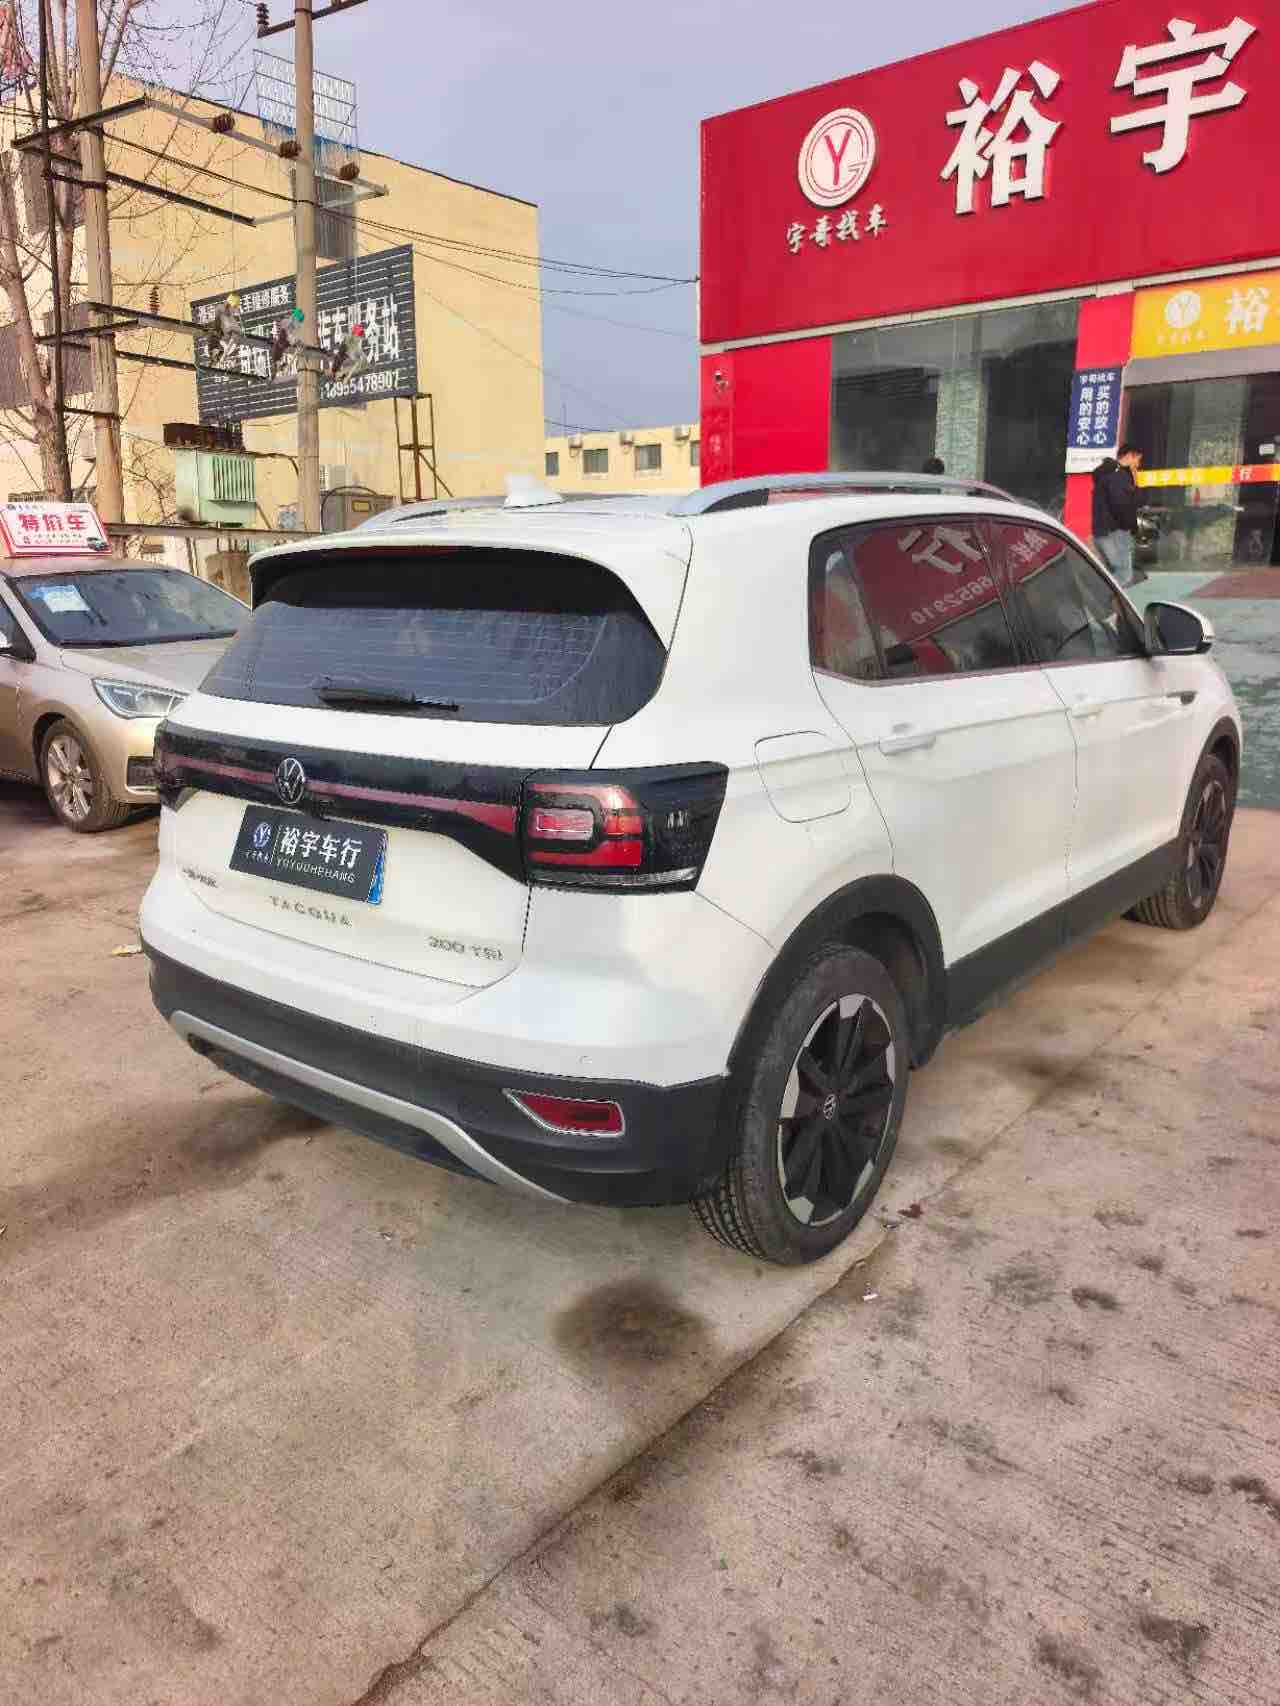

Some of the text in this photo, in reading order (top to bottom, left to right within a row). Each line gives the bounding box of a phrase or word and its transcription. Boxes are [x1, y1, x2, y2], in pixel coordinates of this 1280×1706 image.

[938, 15, 1258, 217] 裕宇
[1076, 386, 1094, 446] 用的安心
[1093, 385, 1111, 445] 买的放心
[279, 826, 363, 870] 裕宇车行
